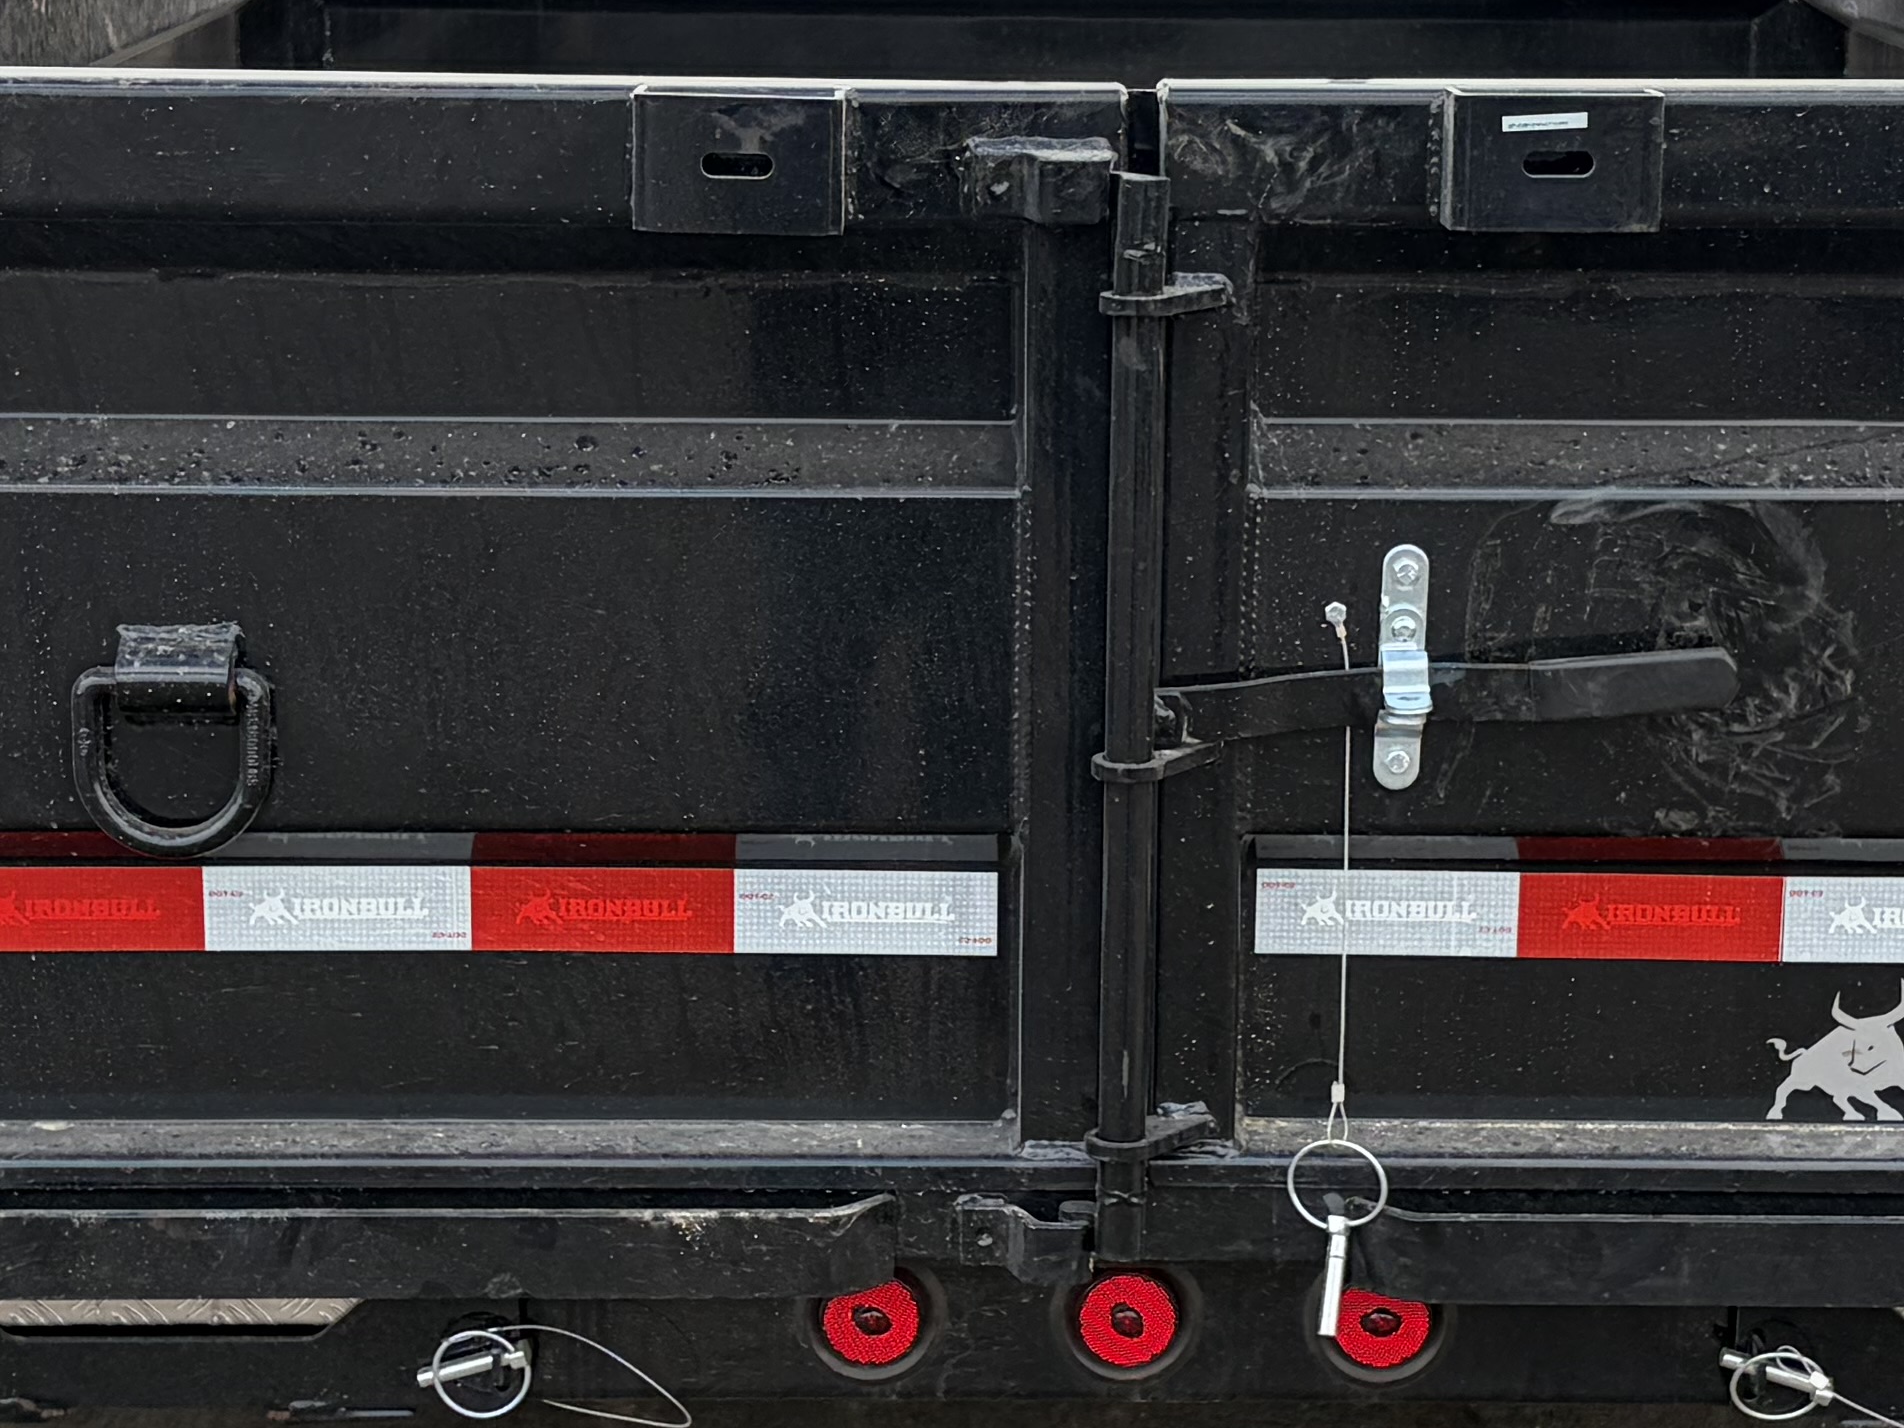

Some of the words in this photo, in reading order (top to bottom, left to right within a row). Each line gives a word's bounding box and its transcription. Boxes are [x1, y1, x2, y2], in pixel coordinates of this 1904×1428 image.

[25, 899, 160, 919] IRONBULL
[293, 897, 429, 918] IRONBULL
[559, 898, 693, 919] IRONBULL
[822, 901, 955, 921] IRONBULL
[1345, 900, 1477, 922] IRONBULL
[1607, 904, 1741, 924] IRONBULL
